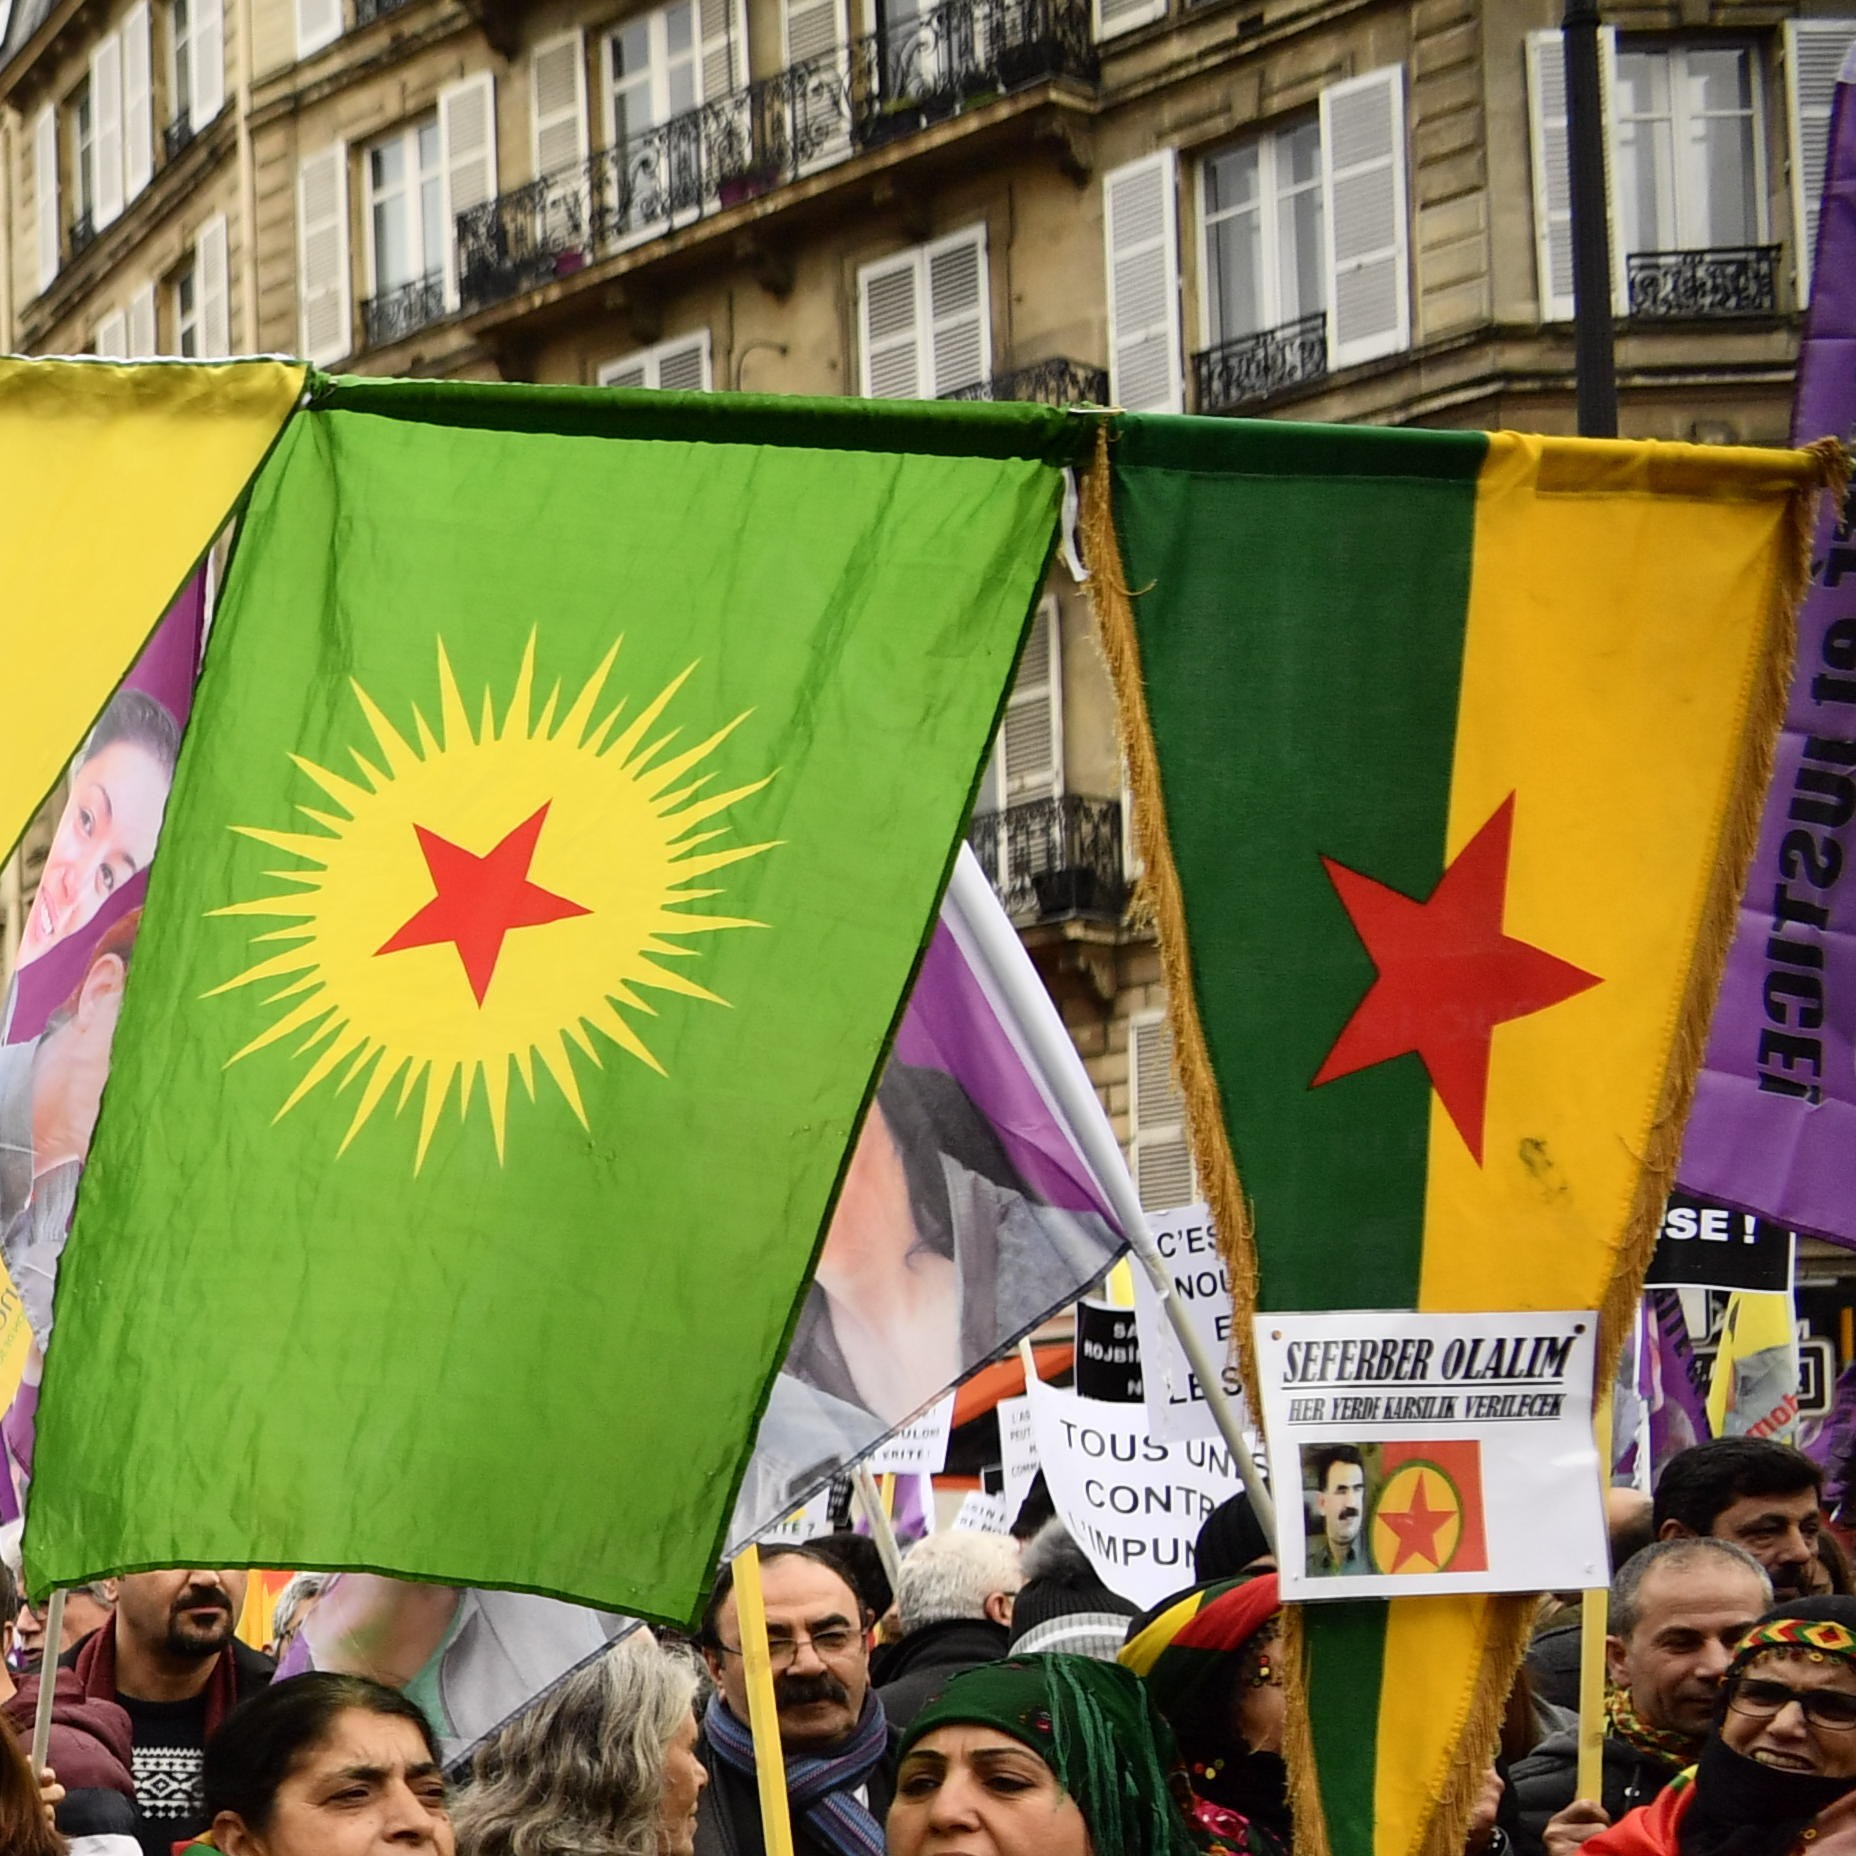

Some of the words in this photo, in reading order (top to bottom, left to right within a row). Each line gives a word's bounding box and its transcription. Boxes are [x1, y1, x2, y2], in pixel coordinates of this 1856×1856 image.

[1283, 1338, 1434, 1383] SEFERBER
[1441, 1335, 1577, 1380] OLALIM
[1288, 1397, 1325, 1421] HER
[1060, 1418, 1170, 1463] TOUS
